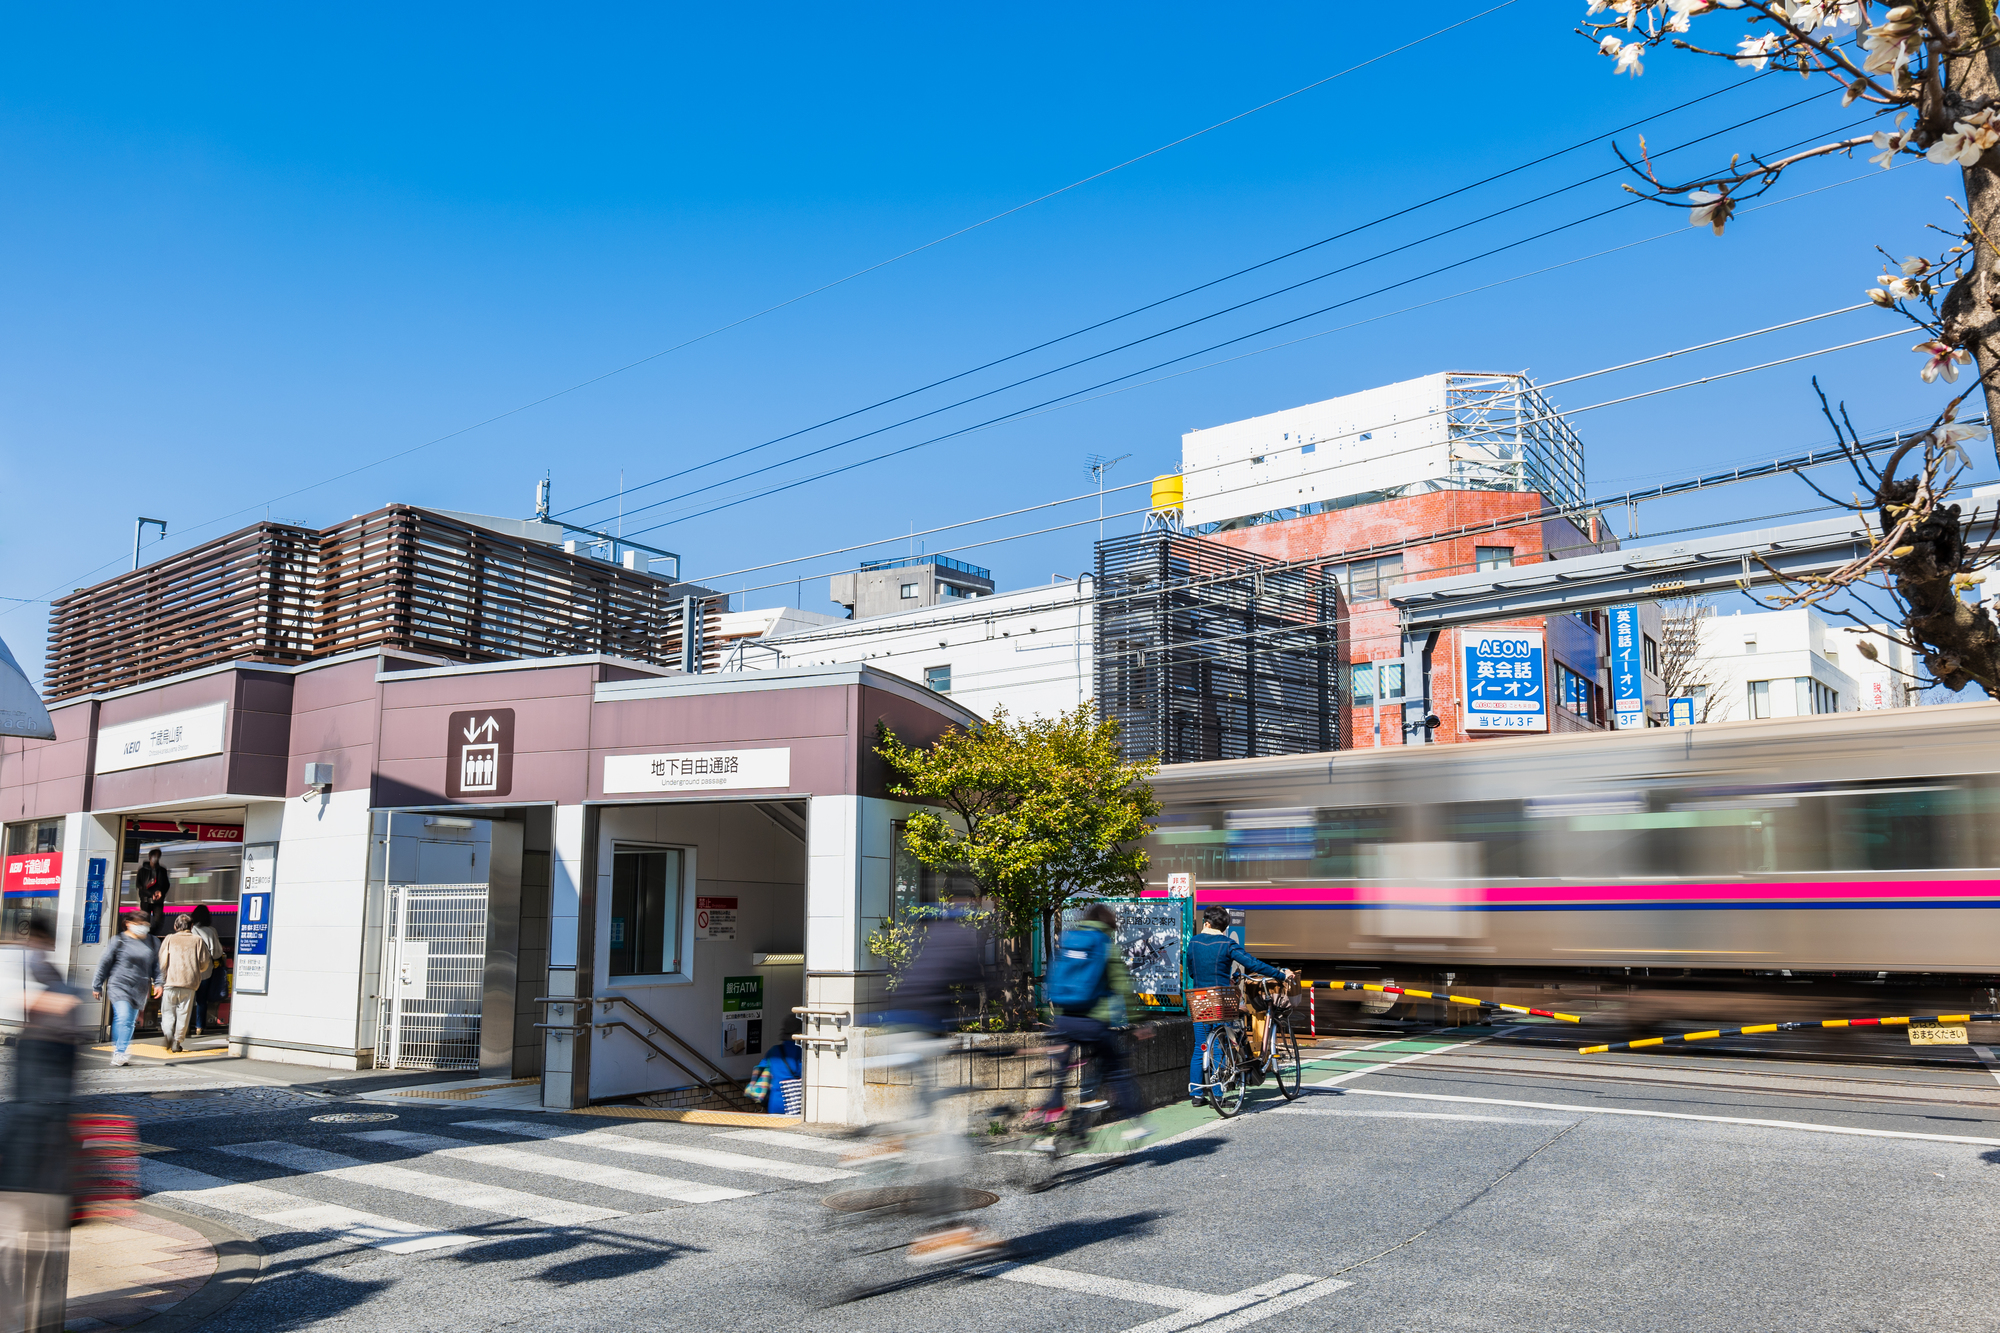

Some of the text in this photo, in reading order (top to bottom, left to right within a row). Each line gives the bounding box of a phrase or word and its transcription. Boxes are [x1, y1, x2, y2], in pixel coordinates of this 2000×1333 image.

[1478, 640, 1529, 656] AEON
[1476, 660, 1533, 679] 英会話
[1470, 680, 1540, 697] イーオン
[1475, 700, 1493, 709] AEON
[1492, 701, 1508, 709] KIDS
[0, 716, 38, 731] ach
[1479, 716, 1534, 727] 当ビル3F
[1620, 714, 1637, 726] 3F
[150, 725, 183, 747] 千歳烏山駅
[123, 740, 141, 755] KEIO
[651, 756, 739, 776] 地下自由通路
[661, 779, 700, 787] Underground
[207, 828, 239, 839] KEIO
[9, 862, 23, 874] KEIO
[1172, 877, 1187, 885] 非常
[1170, 885, 1190, 893] ボタン
[698, 897, 711, 909] 禁止
[726, 981, 758, 994] 銀行ATM
[1912, 1029, 1965, 1040] おまちください
